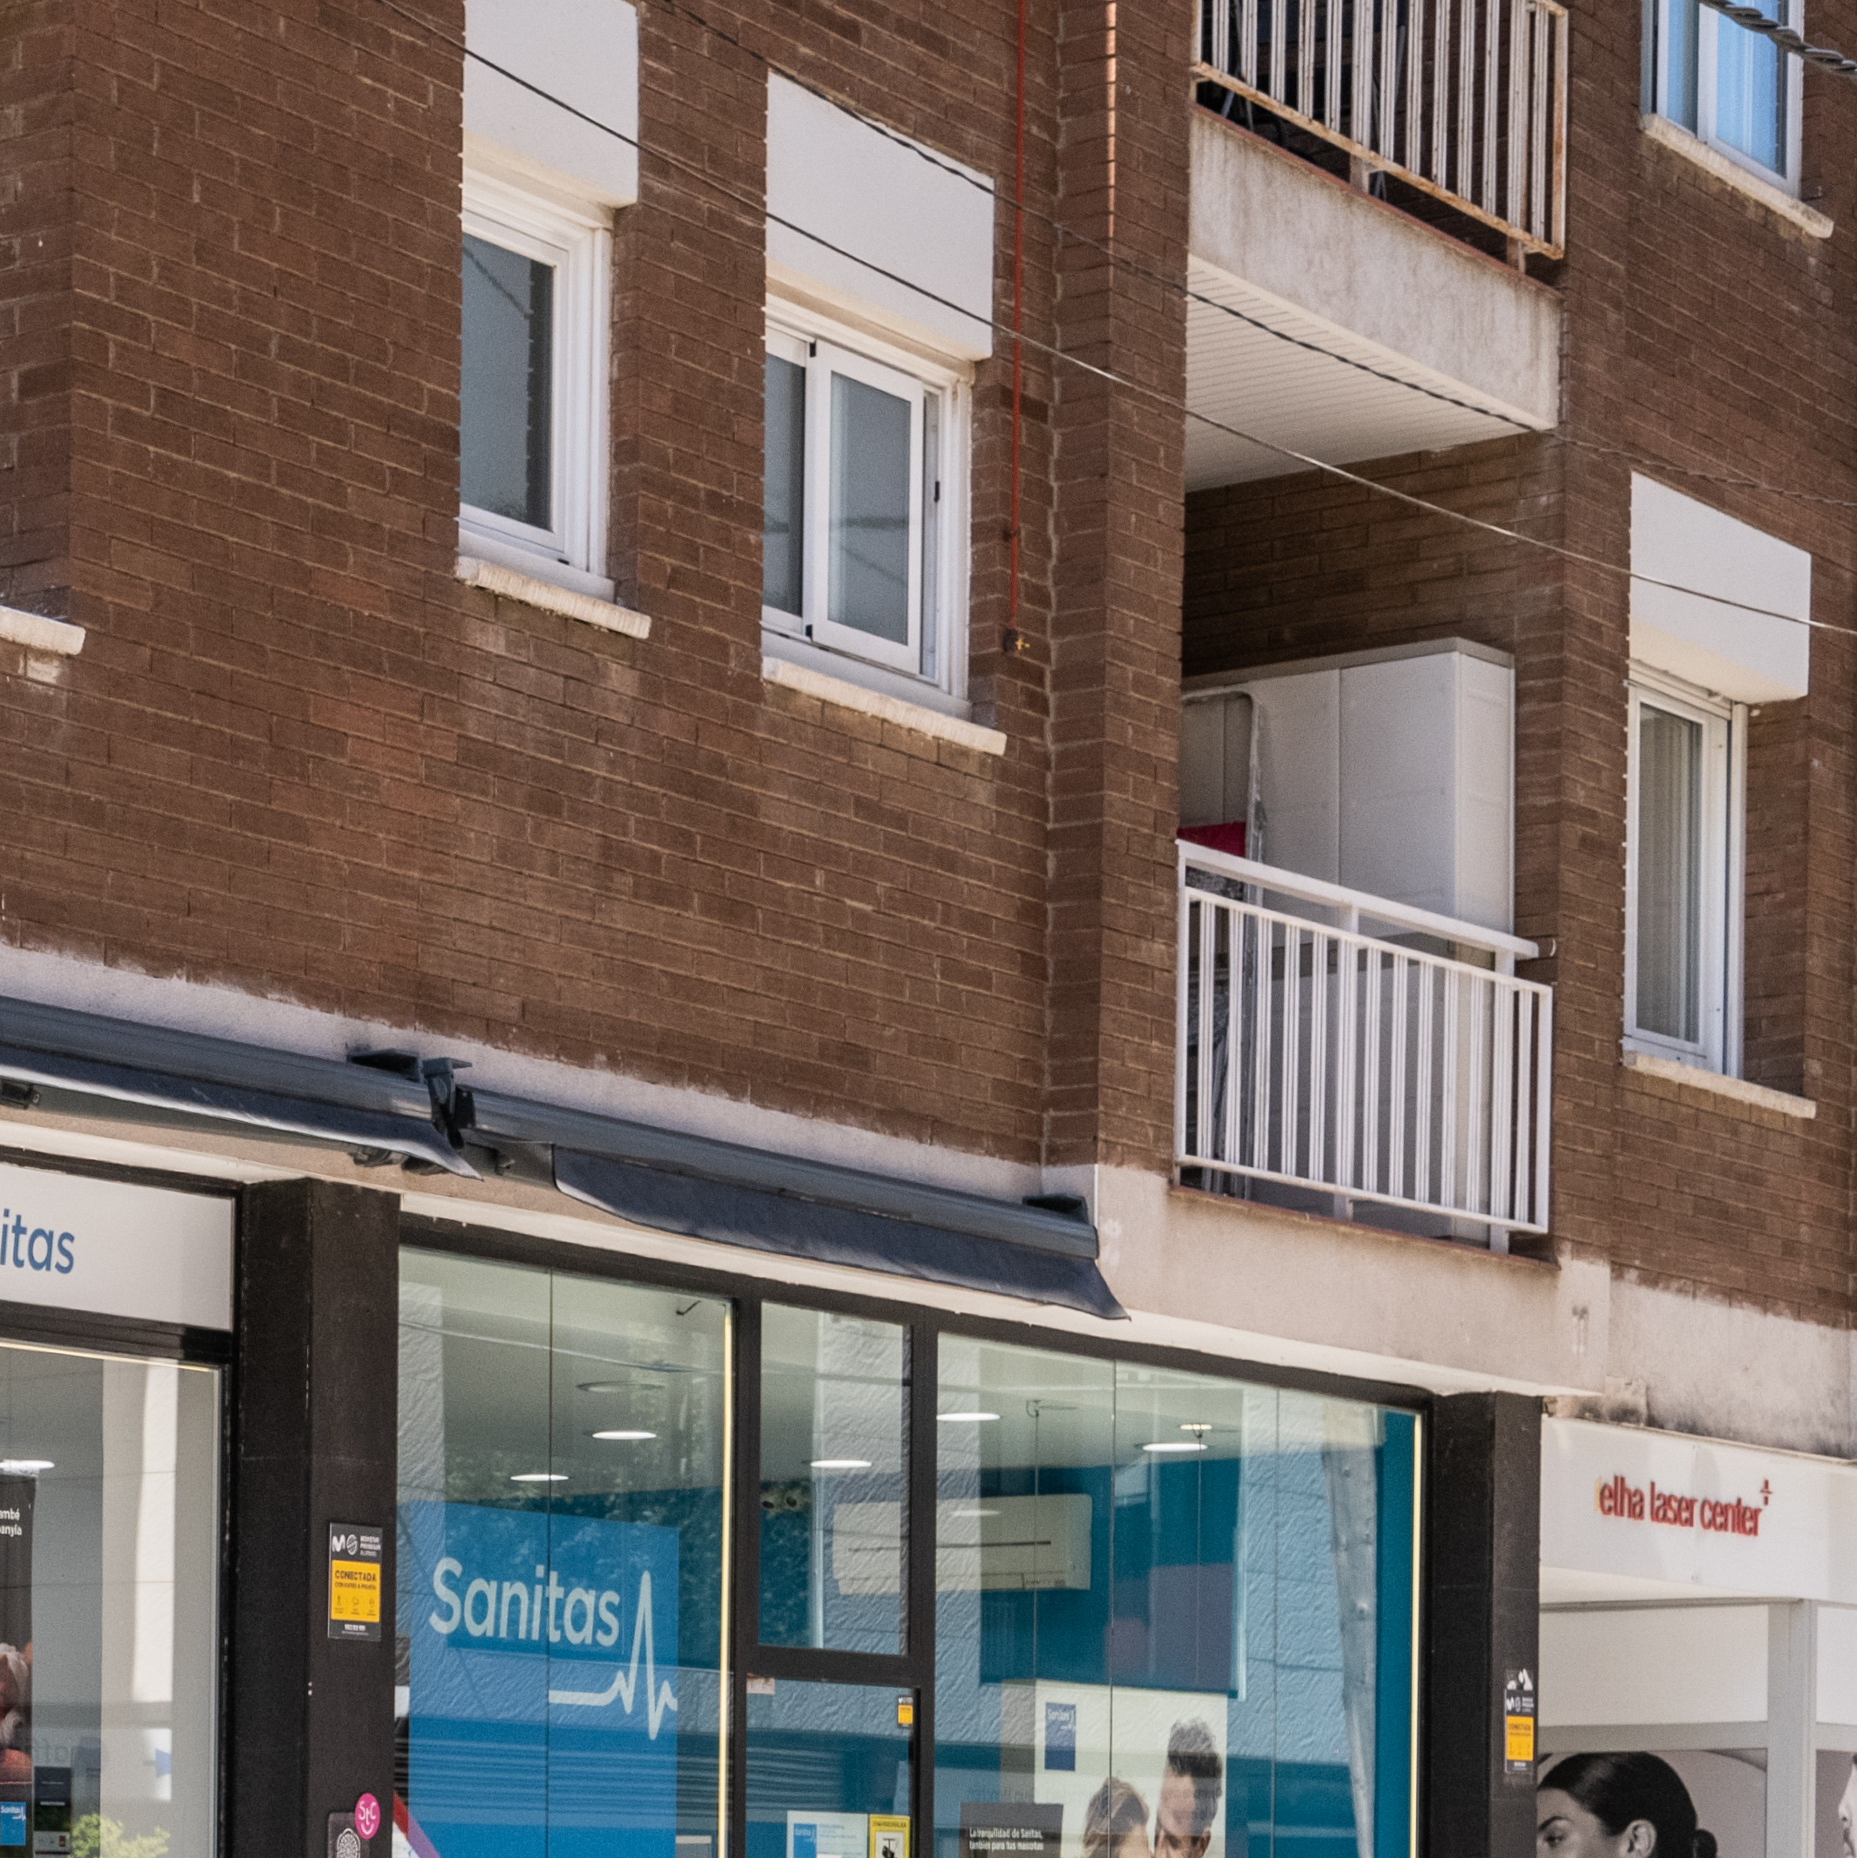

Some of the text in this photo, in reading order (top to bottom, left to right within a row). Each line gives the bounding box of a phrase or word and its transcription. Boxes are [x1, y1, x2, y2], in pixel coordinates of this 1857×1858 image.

[1600, 1475, 1763, 1537] elha laser center
[334, 1570, 376, 1582] CONECTADA
[429, 1555, 621, 1648] Sanitas
[0, 1805, 20, 1814] Sanitas
[1011, 1828, 1020, 1838] de
[991, 1842, 1005, 1852] para
[1006, 1841, 1016, 1850] tus
